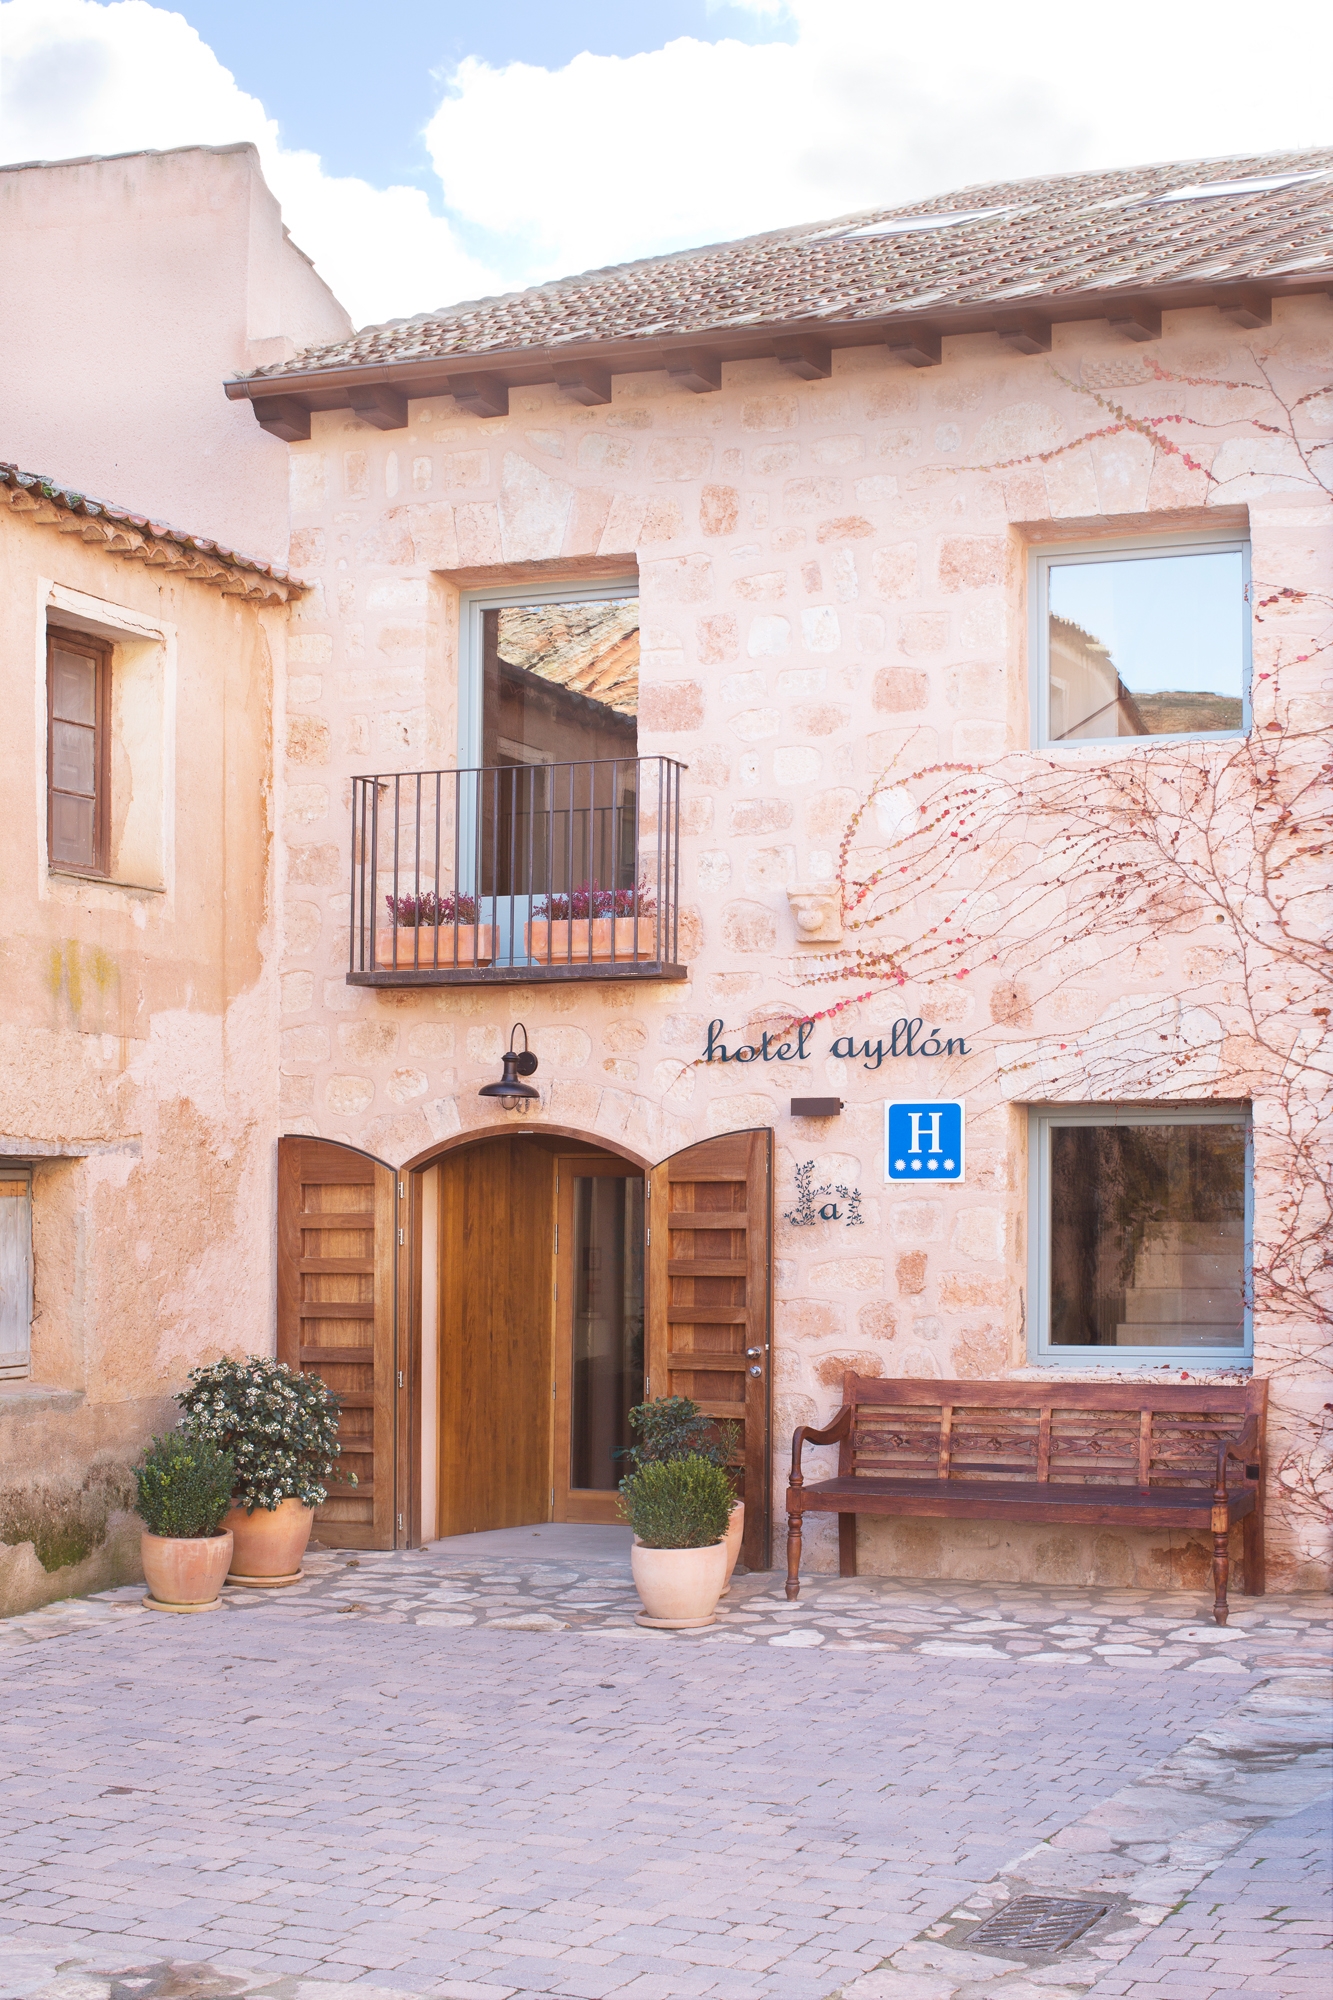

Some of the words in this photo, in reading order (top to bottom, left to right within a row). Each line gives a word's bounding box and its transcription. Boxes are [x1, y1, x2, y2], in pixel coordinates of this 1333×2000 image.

[702, 1018, 815, 1063] hotel
[829, 1017, 972, 1070] ayllón
[907, 1112, 943, 1153] H
